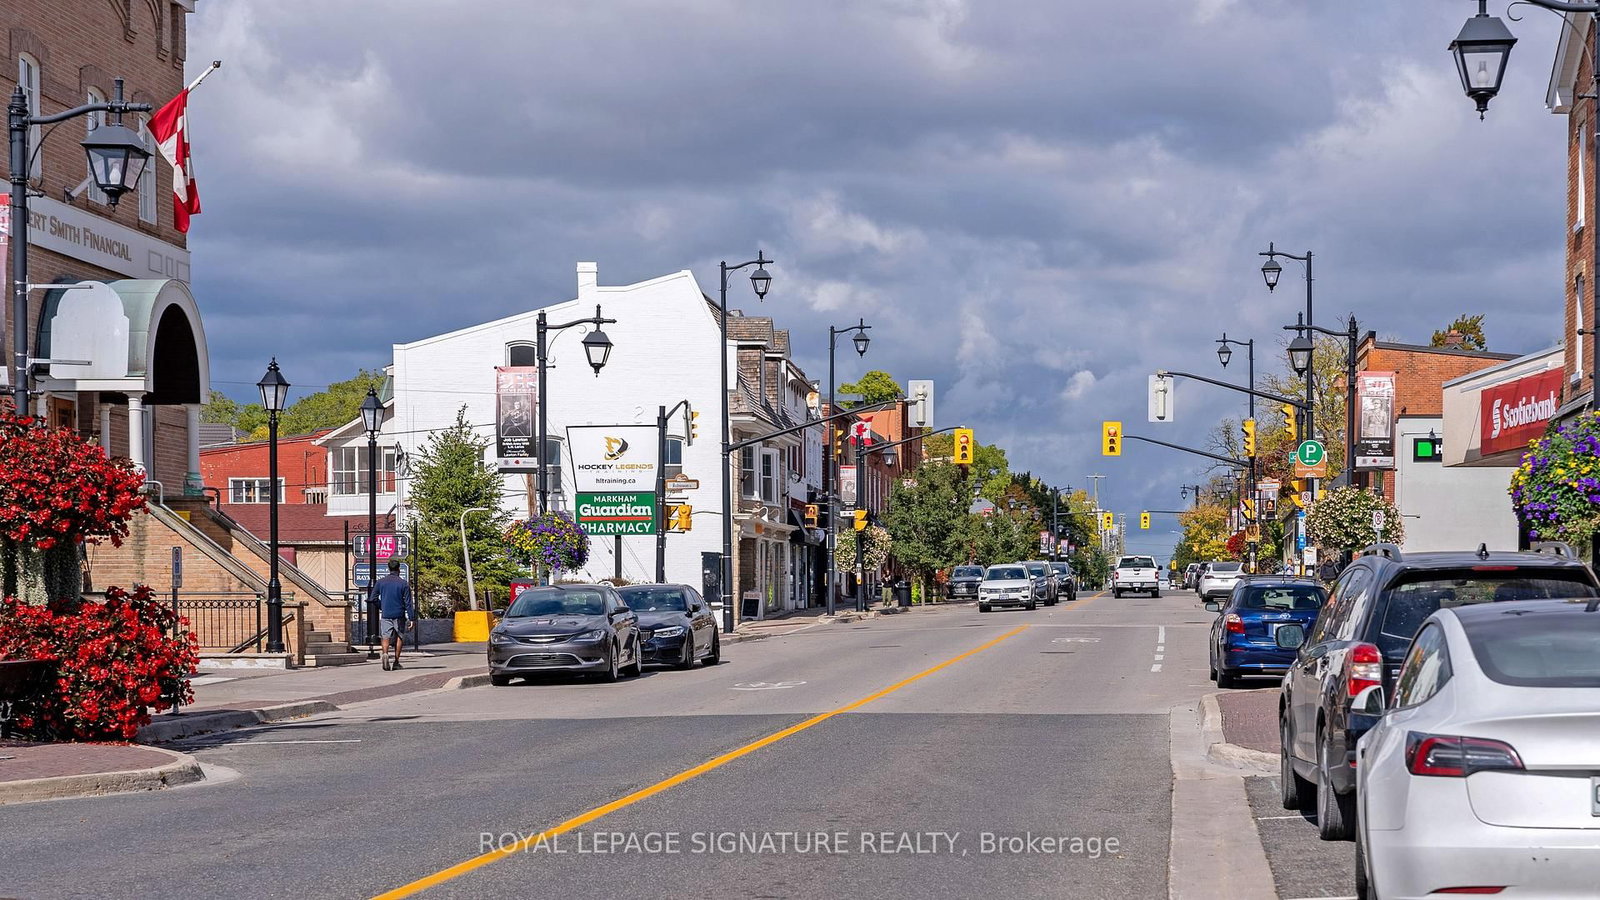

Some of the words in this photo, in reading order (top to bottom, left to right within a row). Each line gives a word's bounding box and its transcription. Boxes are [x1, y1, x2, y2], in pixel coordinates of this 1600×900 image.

[28, 211, 47, 232] ERT
[50, 215, 80, 244] SMITH
[83, 227, 132, 262] FINANCIAL
[1503, 390, 1556, 429] Scotiabank
[1306, 444, 1316, 458] P
[579, 503, 652, 516] Guardian
[580, 522, 652, 533] PHARMACY
